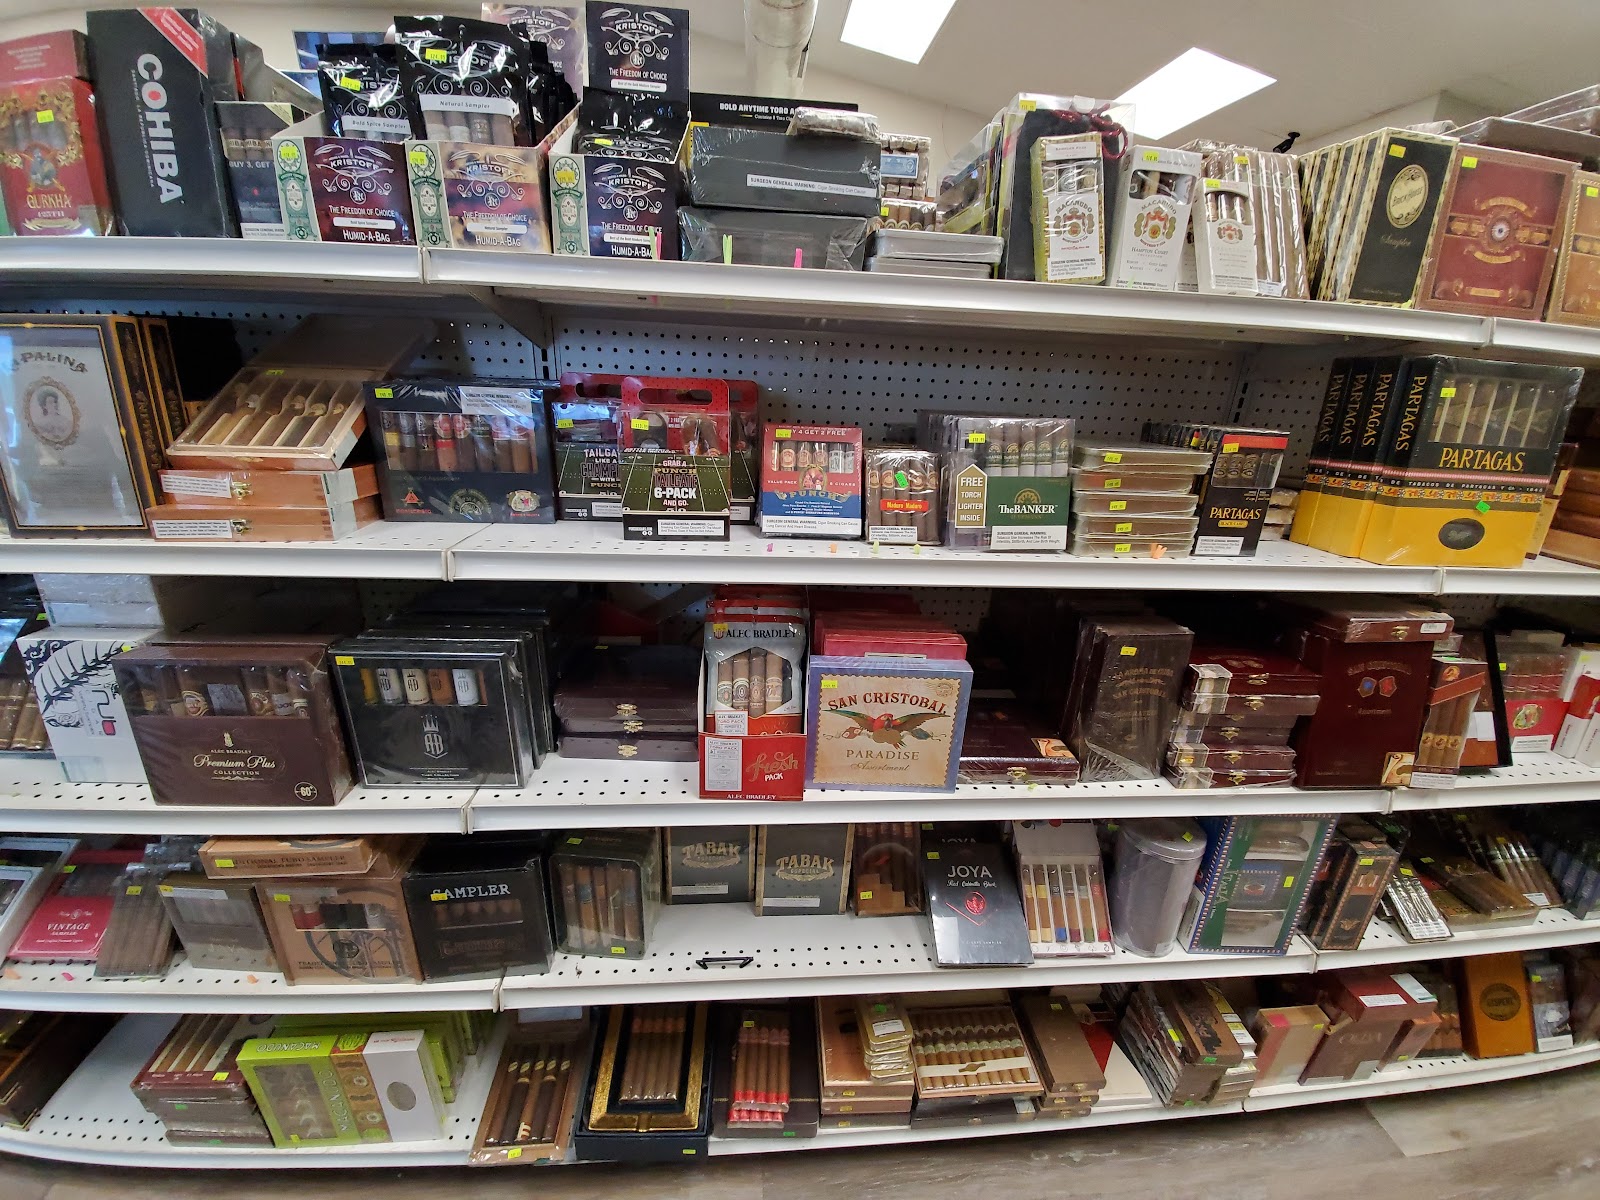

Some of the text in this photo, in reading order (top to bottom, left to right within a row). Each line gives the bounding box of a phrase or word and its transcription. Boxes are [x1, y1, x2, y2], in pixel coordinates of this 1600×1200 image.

[615, 22, 661, 34] KRISTOFF
[609, 67, 619, 76] THE
[619, 68, 643, 78] FREEDOM
[649, 71, 667, 81] CHOICE
[465, 101, 490, 109] Sampler
[719, 102, 788, 114] BOLD ANYTIME TORO
[137, 53, 183, 204] COHIBA
[330, 158, 380, 171] KRISTOFF
[466, 164, 514, 176] KRISTOFF
[608, 178, 654, 190] KRISTOFF
[26, 194, 72, 209] GURKHA
[328, 205, 340, 214] THE
[340, 205, 366, 215] FREEDOM
[374, 208, 395, 218] CHOICE
[508, 213, 527, 222] CHOICE
[601, 222, 611, 230] THE
[612, 222, 636, 232] FREEDOM
[342, 229, 391, 242] HUMID-A-BAG
[475, 235, 521, 247] HUMID-A-BAG
[20, 351, 89, 373] PALINA
[1340, 373, 1368, 444] PARTAGAS
[1362, 373, 1393, 447] PARTAGAS
[1395, 375, 1428, 452] PARTAGAS
[1438, 447, 1526, 473] PARTAGAS
[653, 473, 698, 488] TAILGATE
[960, 477, 984, 487] FREE
[653, 487, 697, 499] 6-PACK
[960, 491, 982, 499] TORCH
[959, 514, 981, 522] INSIDE
[1209, 507, 1262, 519] PARTAGAS
[725, 628, 797, 639] ALEC BRADLEY
[828, 692, 947, 715] SAN CRISTOBAL
[193, 753, 276, 769] Premium Plus
[846, 749, 920, 761] PARADISE
[745, 752, 799, 783] fresh
[850, 761, 910, 772] Assortment
[764, 772, 784, 782] PACK
[682, 841, 741, 857] TABAK
[775, 854, 835, 870] TABAK
[947, 865, 993, 878] JOYA
[47, 923, 92, 931] VINTAGE
